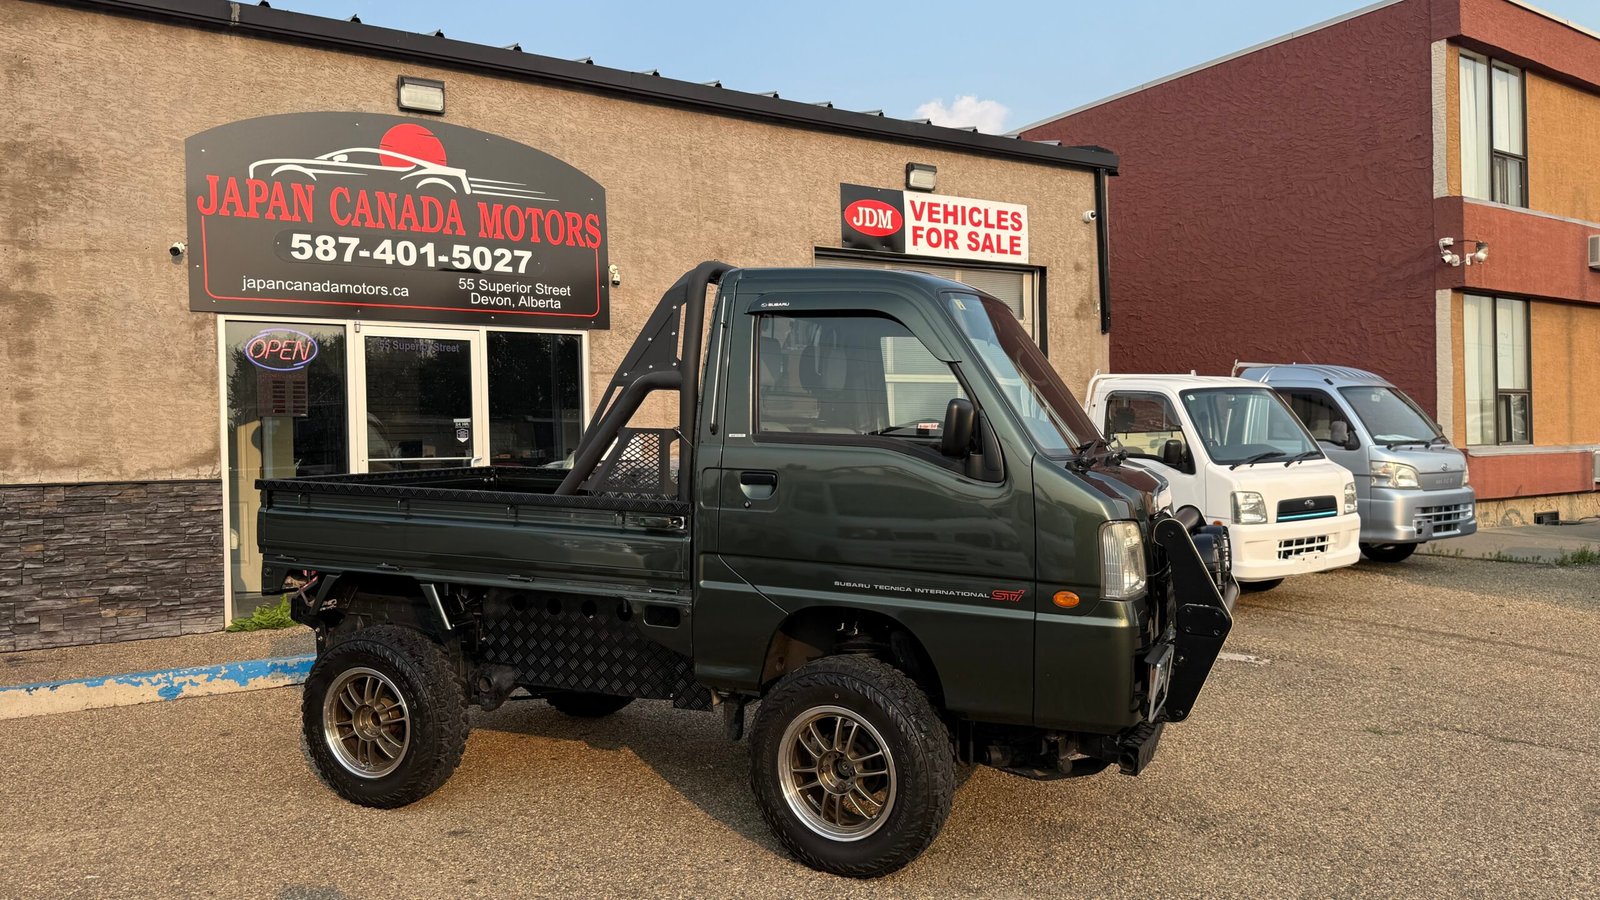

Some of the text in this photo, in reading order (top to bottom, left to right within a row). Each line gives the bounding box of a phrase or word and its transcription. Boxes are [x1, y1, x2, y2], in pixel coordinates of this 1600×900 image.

[196, 174, 602, 250] JAPAN CANADA MOTORS
[852, 206, 893, 230] JDM
[909, 199, 1023, 232] VEHICLES
[911, 225, 1022, 256] FOR SALE
[289, 232, 533, 274] 587-401-5027
[241, 275, 410, 297] japancanadamotors.ca
[458, 277, 571, 296] 55 Superior Street
[470, 292, 562, 309] Devon, Alberta
[249, 338, 312, 361] OPEN
[433, 342, 460, 353] Street
[834, 581, 871, 589] SUBARU
[873, 584, 912, 592] TECNICA
[914, 587, 990, 599] INTERNATIONAL
